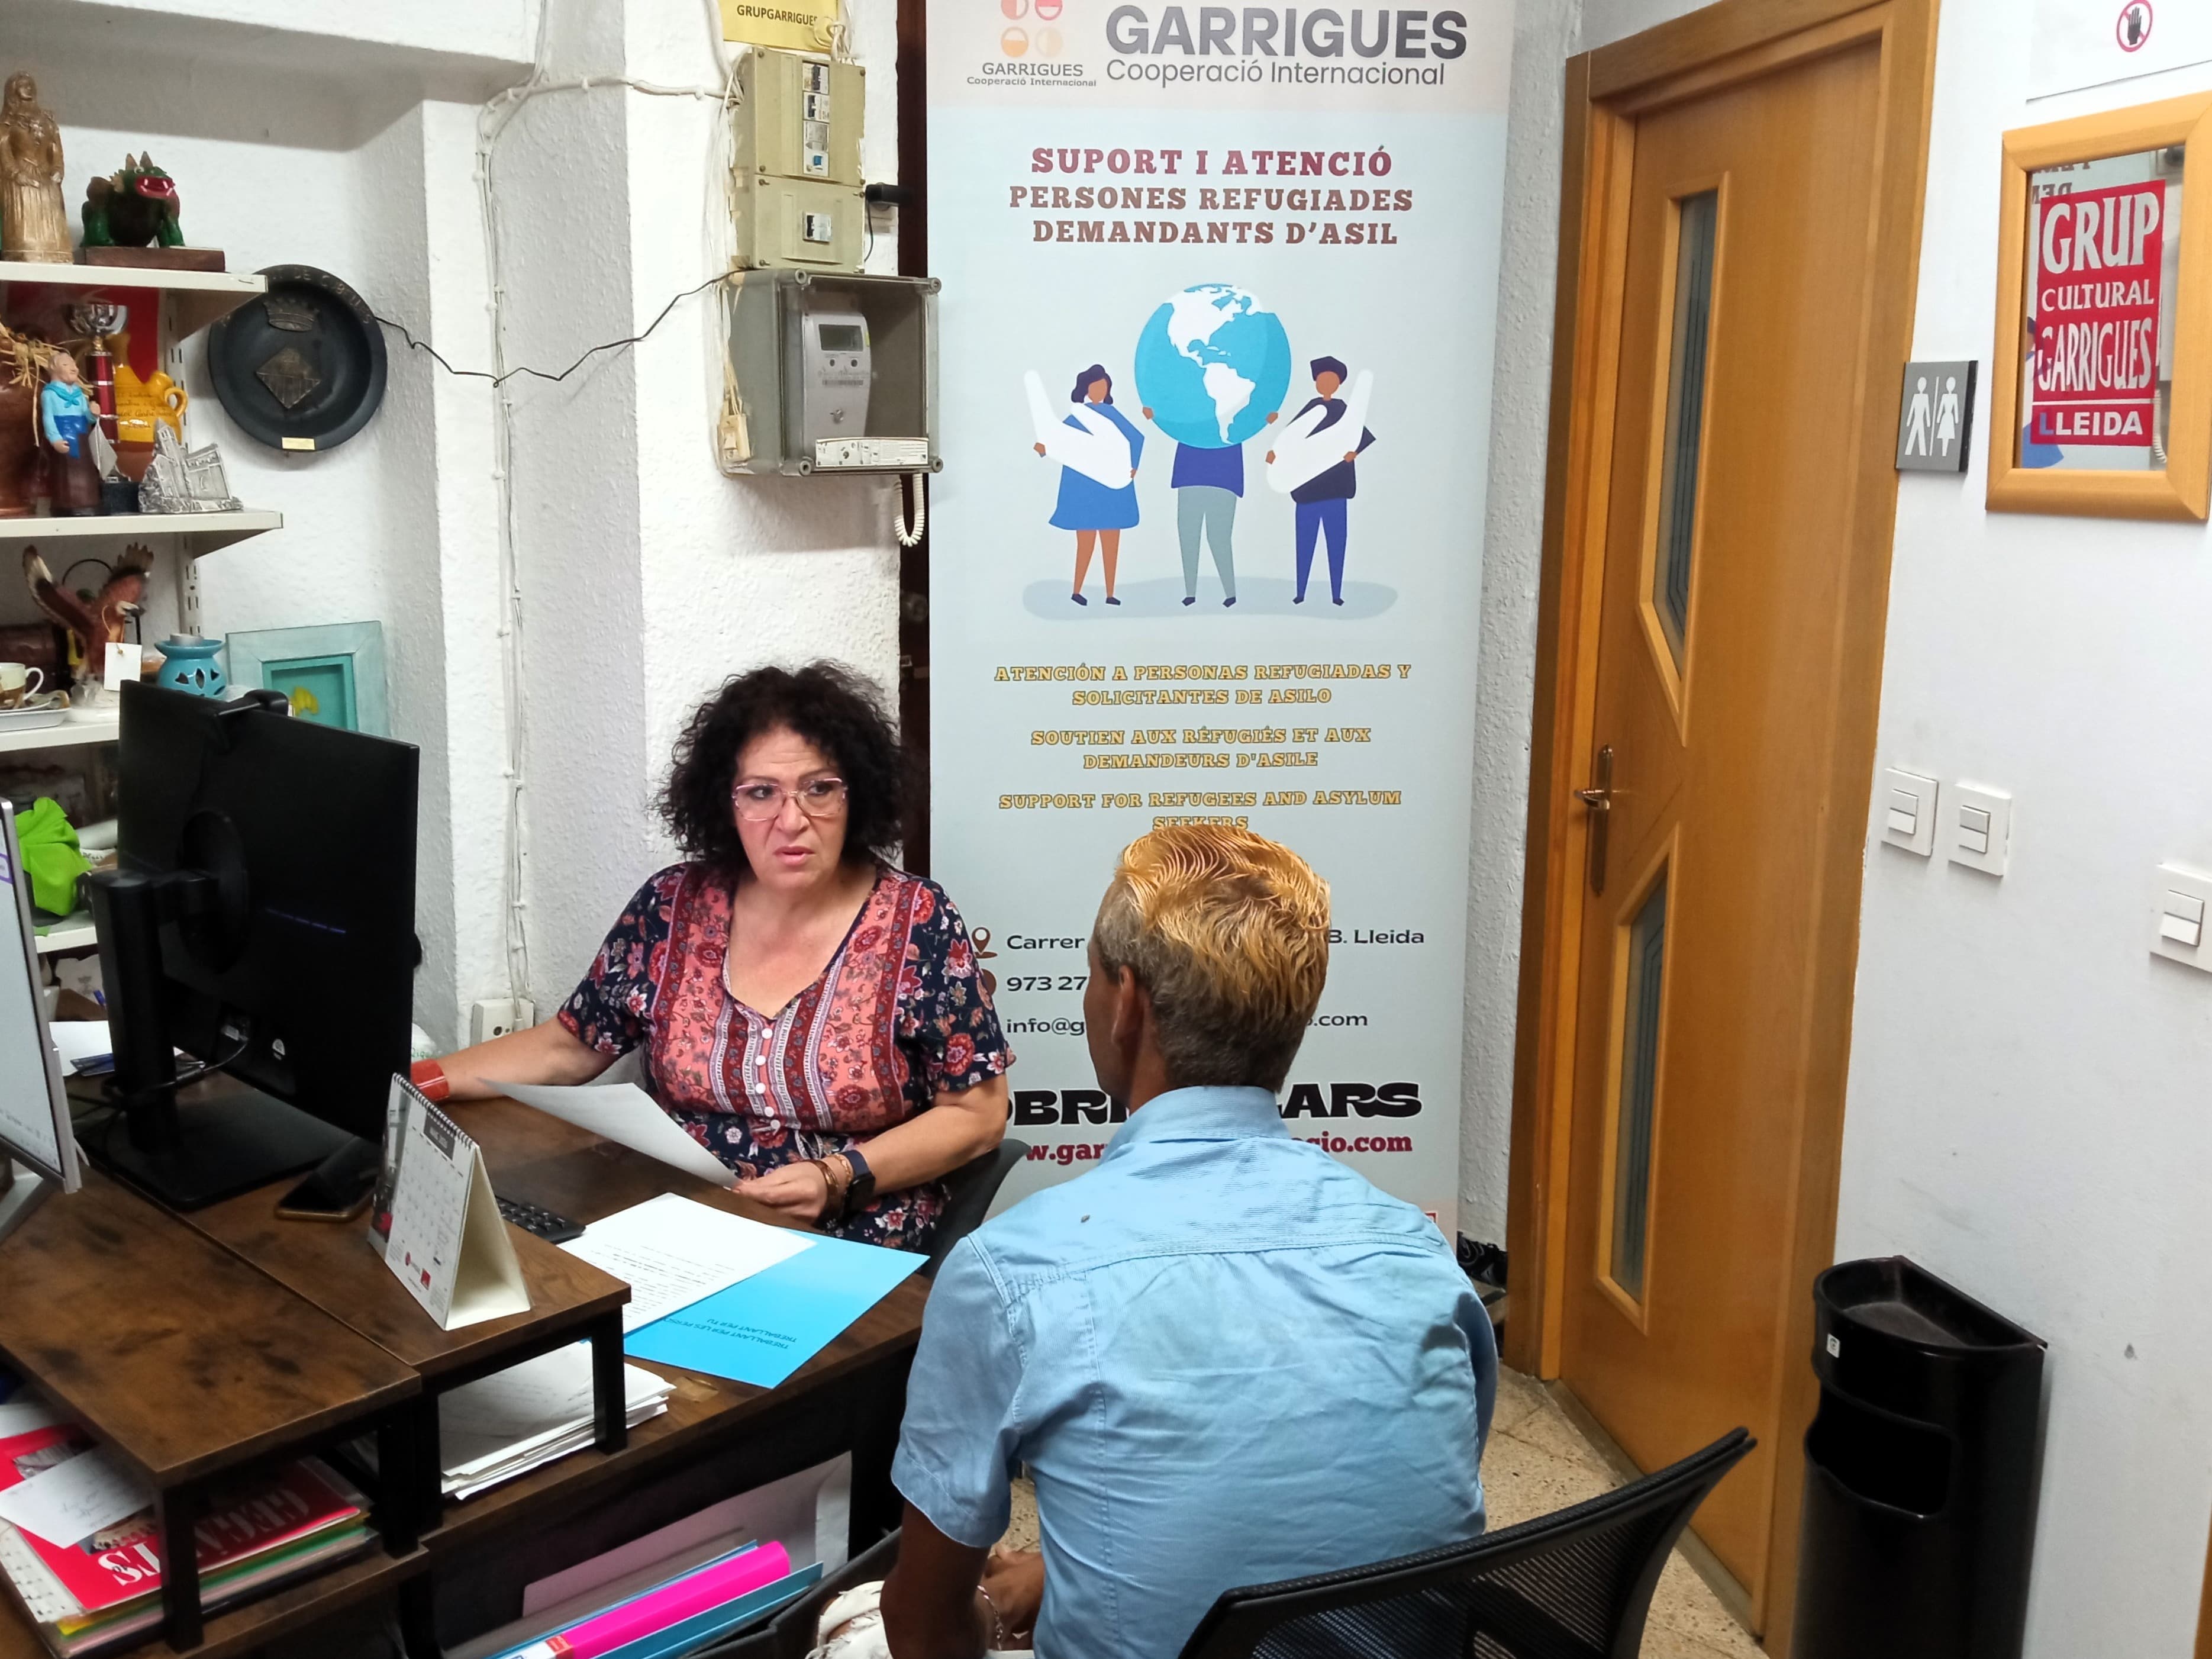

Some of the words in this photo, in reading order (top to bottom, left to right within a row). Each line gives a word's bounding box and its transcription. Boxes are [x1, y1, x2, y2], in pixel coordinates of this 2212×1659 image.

[1106, 5, 1468, 59] GARRIGUES
[967, 76, 1027, 86] Cooperació
[1030, 78, 1097, 87] Internacional
[982, 62, 1084, 76] GARRIGUES
[1107, 59, 1263, 88] Cooperació
[1271, 60, 1445, 86] Internacional
[1031, 147, 1183, 175] SUPORT
[1196, 150, 1208, 175] I
[1223, 145, 1392, 177] ATENCIÓ
[1009, 186, 1186, 211] PERSONES
[1199, 188, 1413, 212] REFUGIADES
[1033, 220, 1274, 244] DEMANDANTS
[1285, 222, 1398, 245] D'ASIL
[2043, 191, 2160, 273] GRUP
[2042, 278, 2154, 312] CULTURAL
[2038, 317, 2153, 392] GARRIGUES
[2039, 410, 2143, 436] LLEIDA
[994, 663, 1106, 681] ATENCIÓN
[1113, 666, 1127, 681] A
[1134, 665, 1248, 680] PERSONAS
[1254, 664, 1392, 679] REFUGIADAS
[1397, 664, 1411, 679] Y
[1072, 690, 1229, 706] SOLICITANTES
[1235, 689, 1262, 704] DE
[1269, 688, 1331, 704] ASILO
[1031, 729, 1125, 745] SOUTIEN
[1131, 729, 1176, 744] AUX
[1183, 725, 1286, 744] RÉFUGIÉS
[1292, 728, 1318, 743] ET
[1324, 727, 1371, 743] AUX
[1084, 753, 1230, 769] DEMANDEURS
[1236, 752, 1318, 768] D'ASILE
[999, 793, 1095, 809] SUPPORT
[1101, 793, 1143, 808] FOR
[1148, 792, 1257, 807] REFUGEES
[1263, 791, 1307, 806] AND
[1313, 790, 1401, 806] ASYLUM
[1007, 935, 1085, 949] Carrer
[1354, 929, 1424, 943] Lleida
[1007, 977, 1052, 991] 973
[1058, 976, 1088, 991] 27
[1277, 1082, 1422, 1118] ARS
